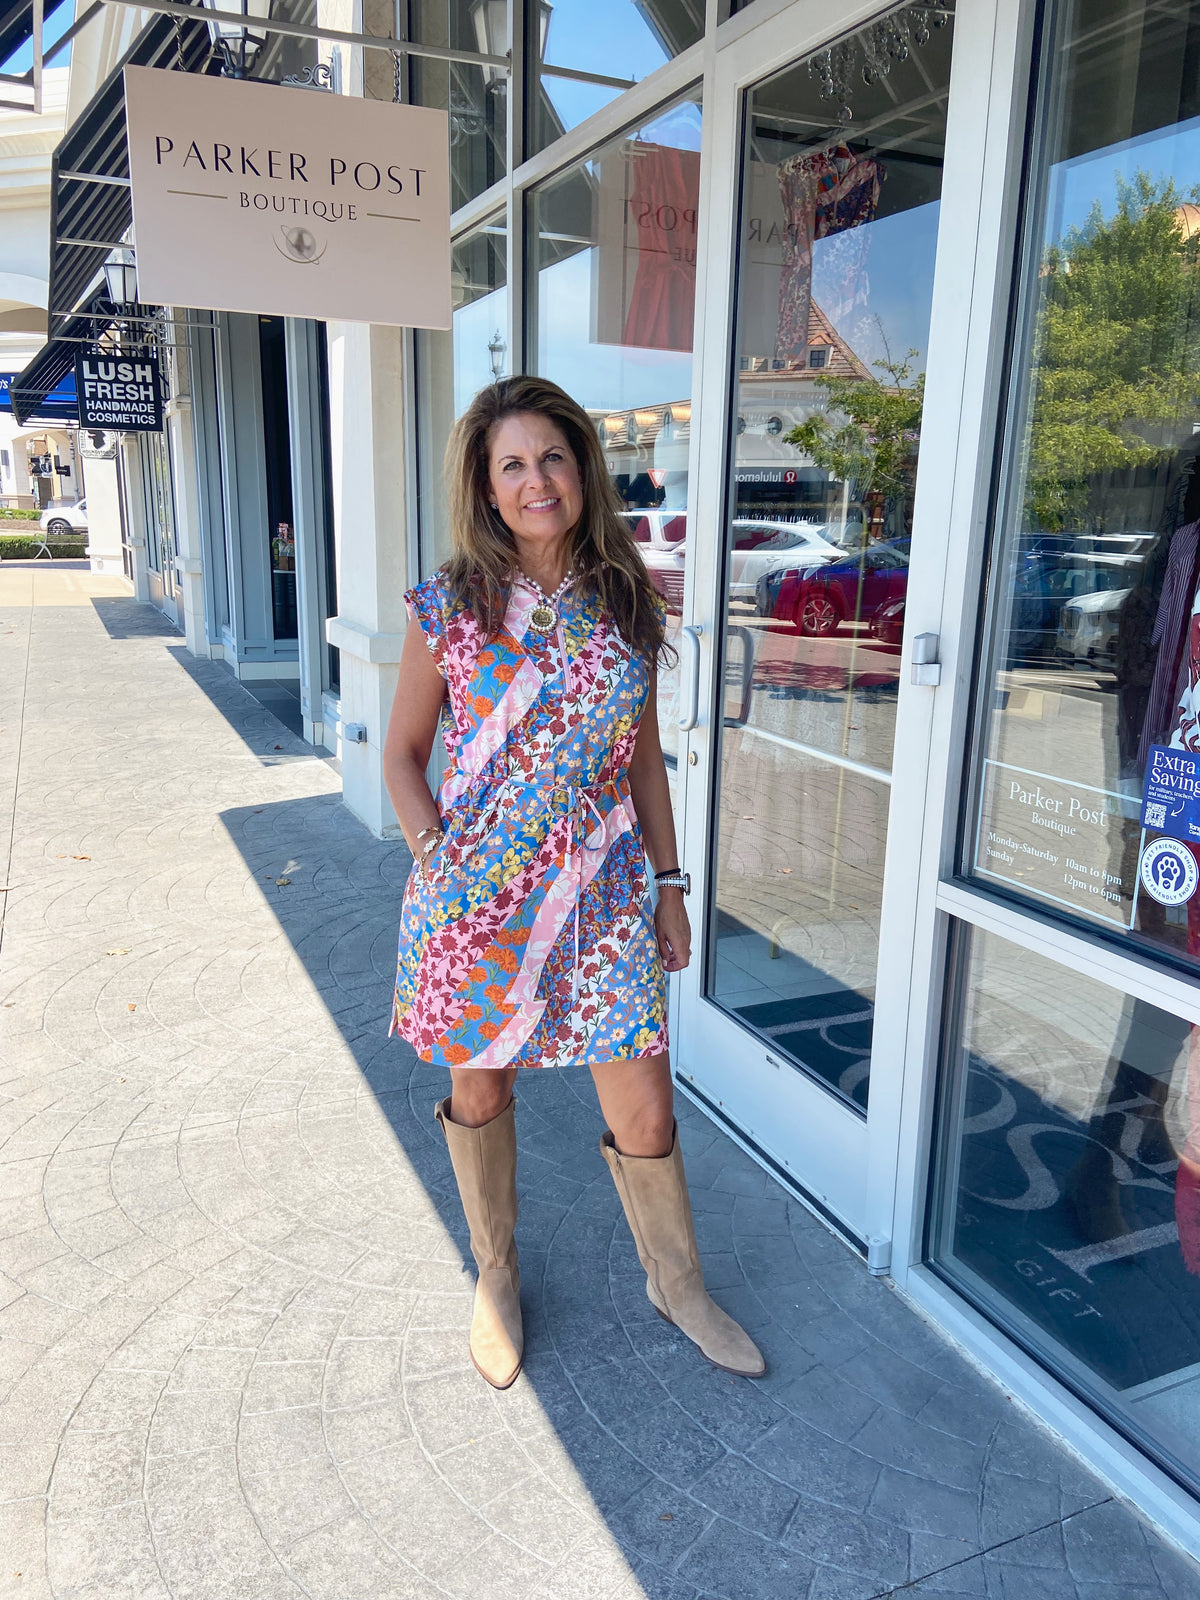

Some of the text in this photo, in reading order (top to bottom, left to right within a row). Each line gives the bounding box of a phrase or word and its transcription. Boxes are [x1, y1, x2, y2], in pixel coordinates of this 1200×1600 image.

[155, 136, 427, 196] PARKER POST
[239, 192, 358, 223] BOUTIQUE
[82, 361, 153, 383] LUSH
[84, 382, 155, 401] FRESH
[86, 400, 156, 413] HANDMADE
[87, 412, 156, 424] COSMETICS
[1152, 750, 1196, 775] Extra
[1009, 781, 1108, 827] Parker Post
[1031, 811, 1076, 837] Boutique
[989, 831, 1122, 886] Monday-Saturday 10am to 8pm
[1155, 843, 1184, 855] FRIENDLY
[1184, 855, 1194, 874] SHOP
[985, 846, 1121, 902] Sunday 12pm to 6pm
[1150, 883, 1177, 900] FRIENDLY
[1178, 883, 1191, 898] SHOP
[1014, 1258, 1103, 1317] GIFT
